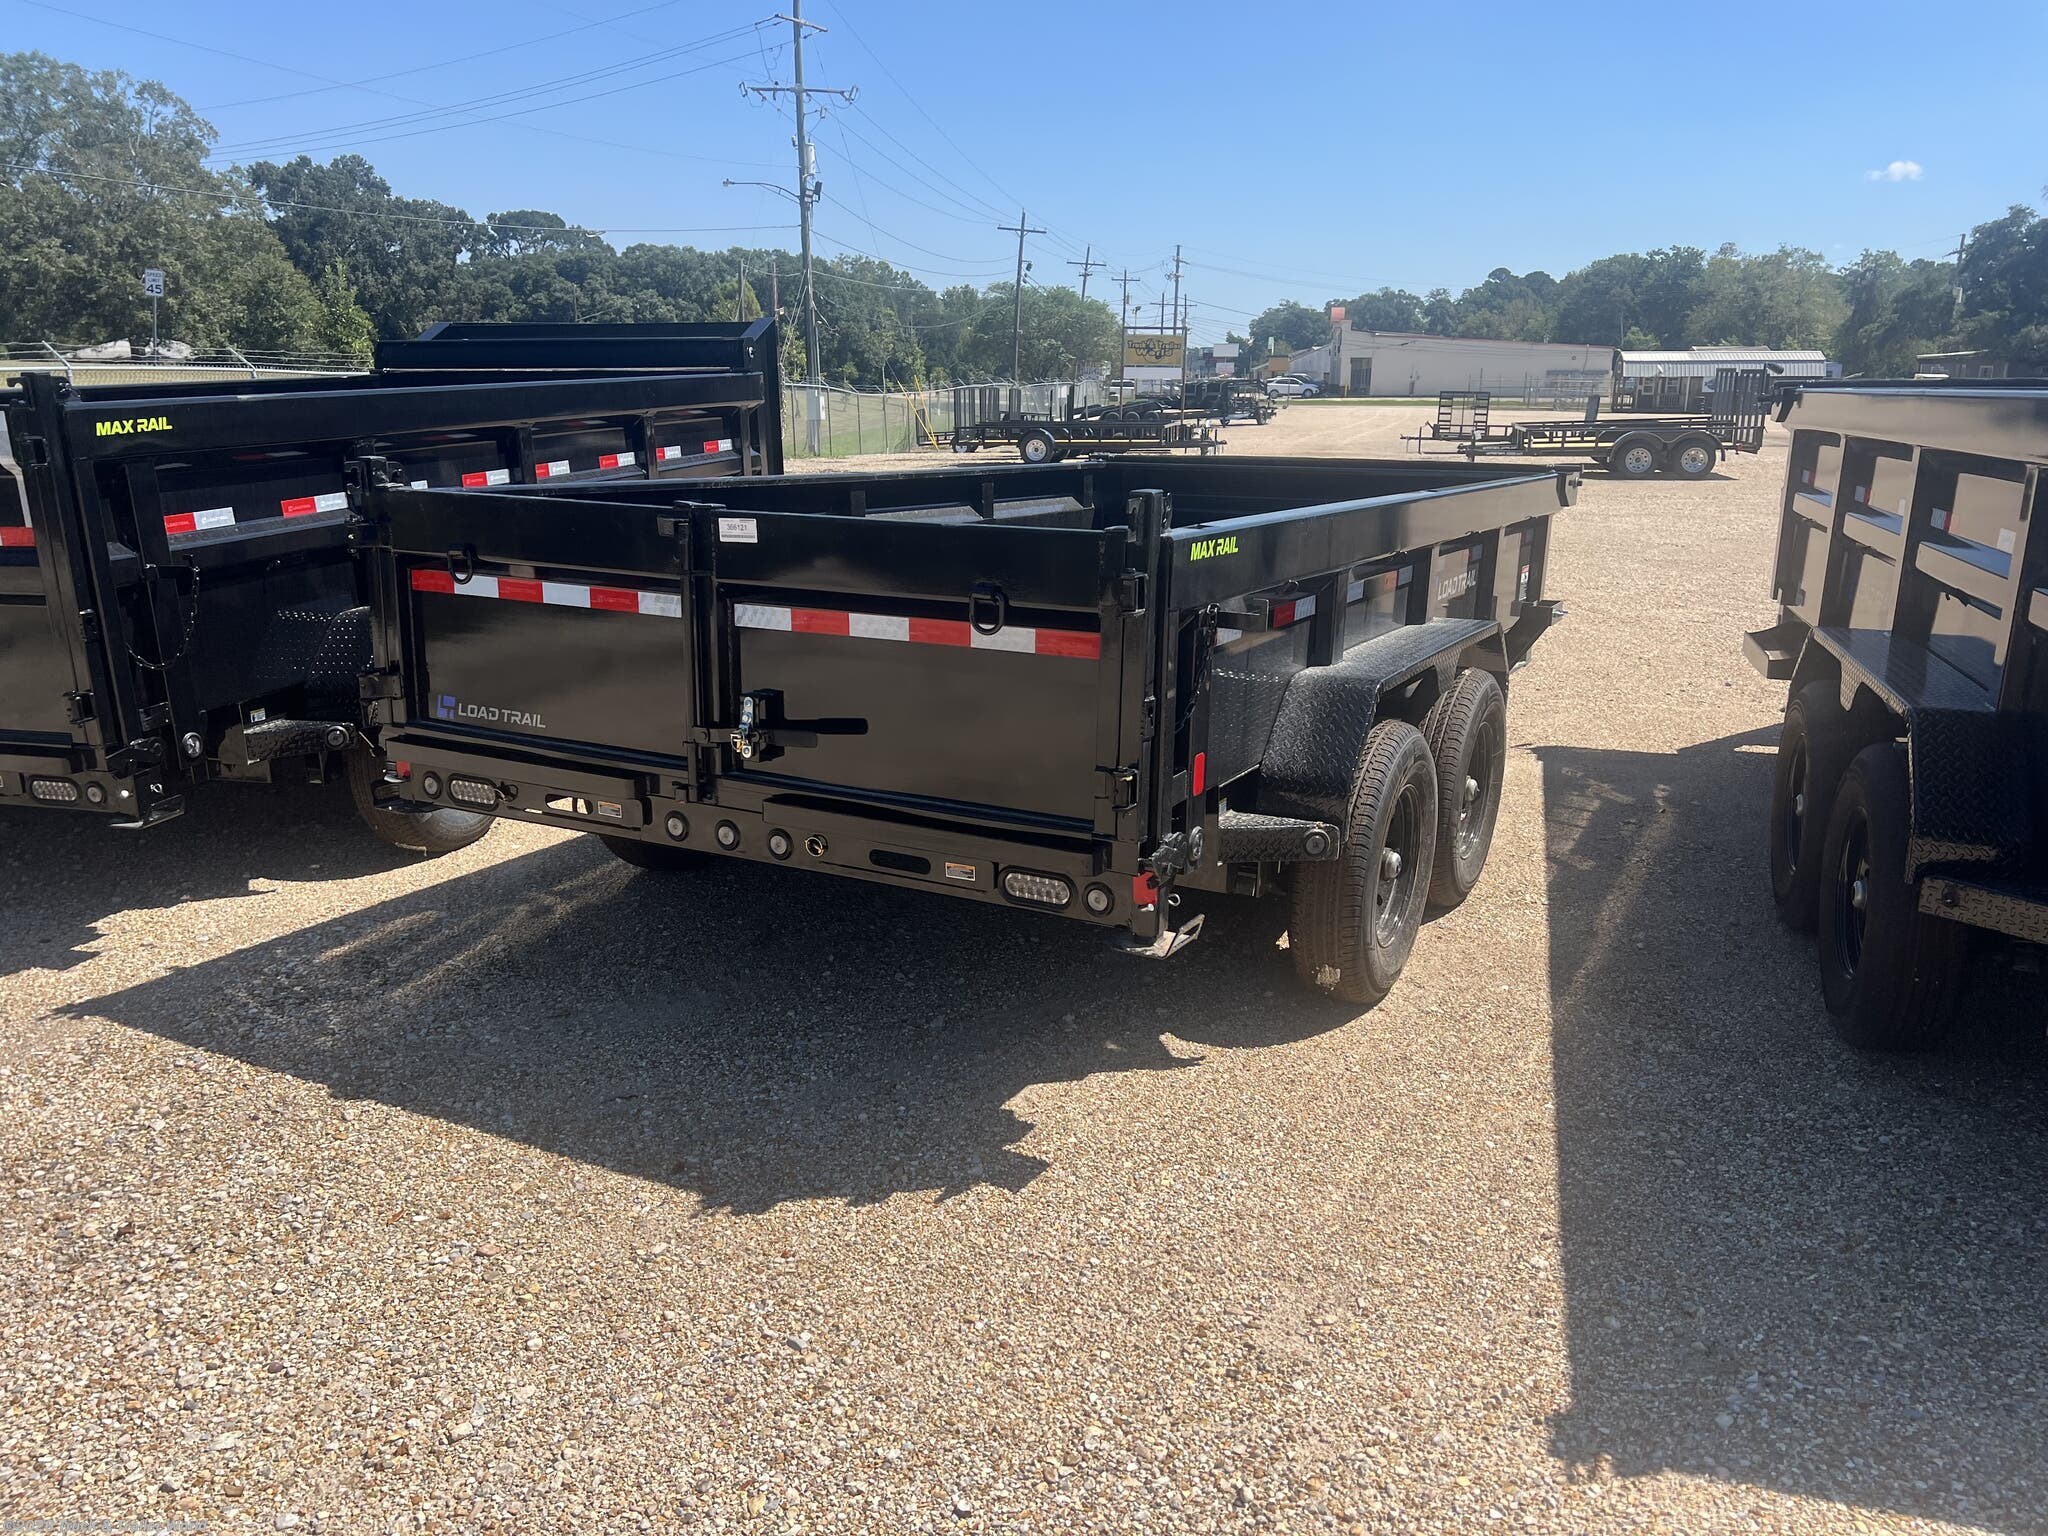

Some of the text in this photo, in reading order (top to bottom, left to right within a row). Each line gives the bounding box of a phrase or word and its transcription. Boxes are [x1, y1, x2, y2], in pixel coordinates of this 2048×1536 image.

[146, 284, 162, 294] 45
[96, 416, 173, 436] MAX RAIL
[1190, 536, 1239, 561] MAX RAIL
[458, 703, 547, 729] LOAD TRAIL
